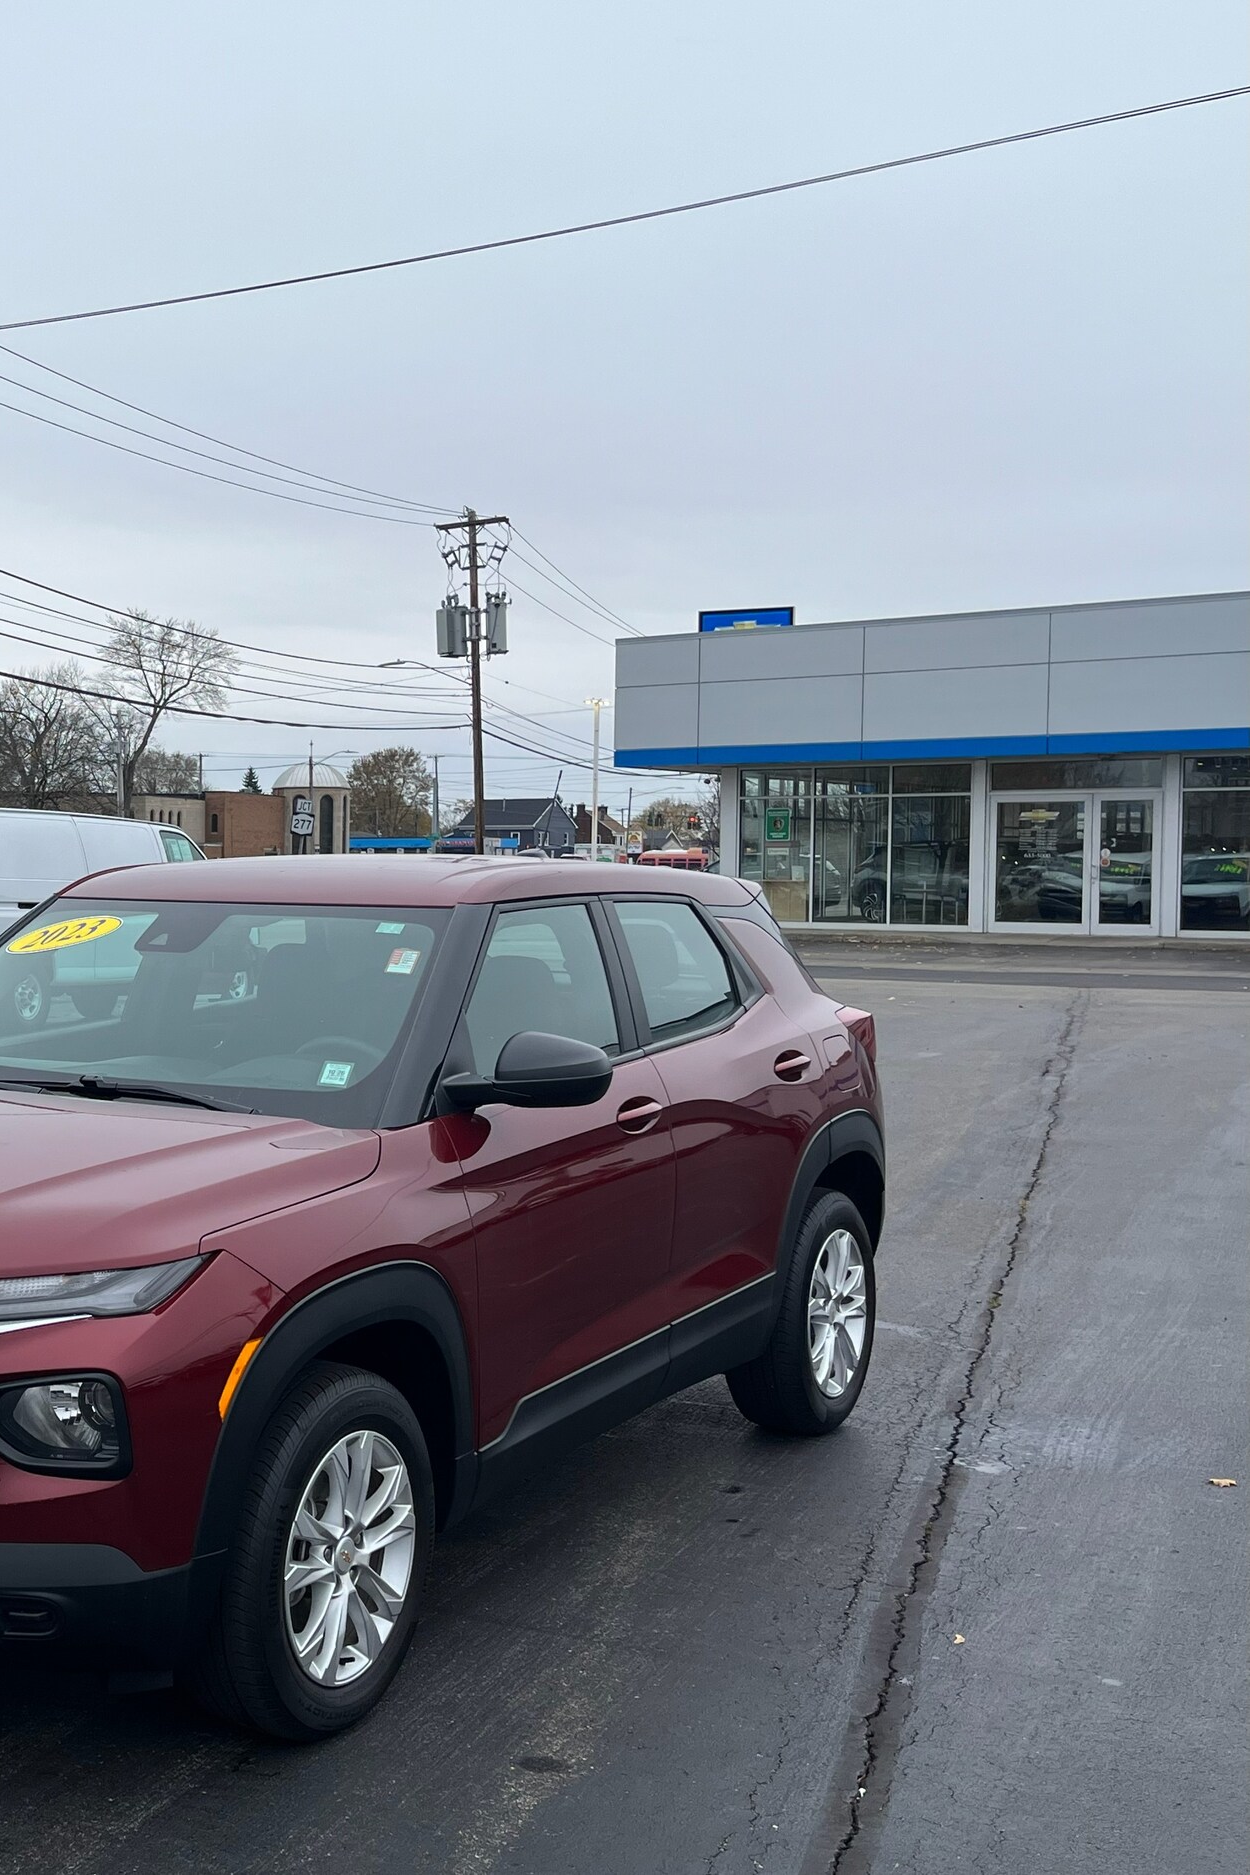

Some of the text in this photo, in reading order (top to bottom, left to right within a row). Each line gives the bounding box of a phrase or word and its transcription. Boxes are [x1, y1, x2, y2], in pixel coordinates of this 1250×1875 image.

[298, 801, 312, 811] JCT
[293, 819, 312, 830] 277
[20, 919, 107, 950] 2023
